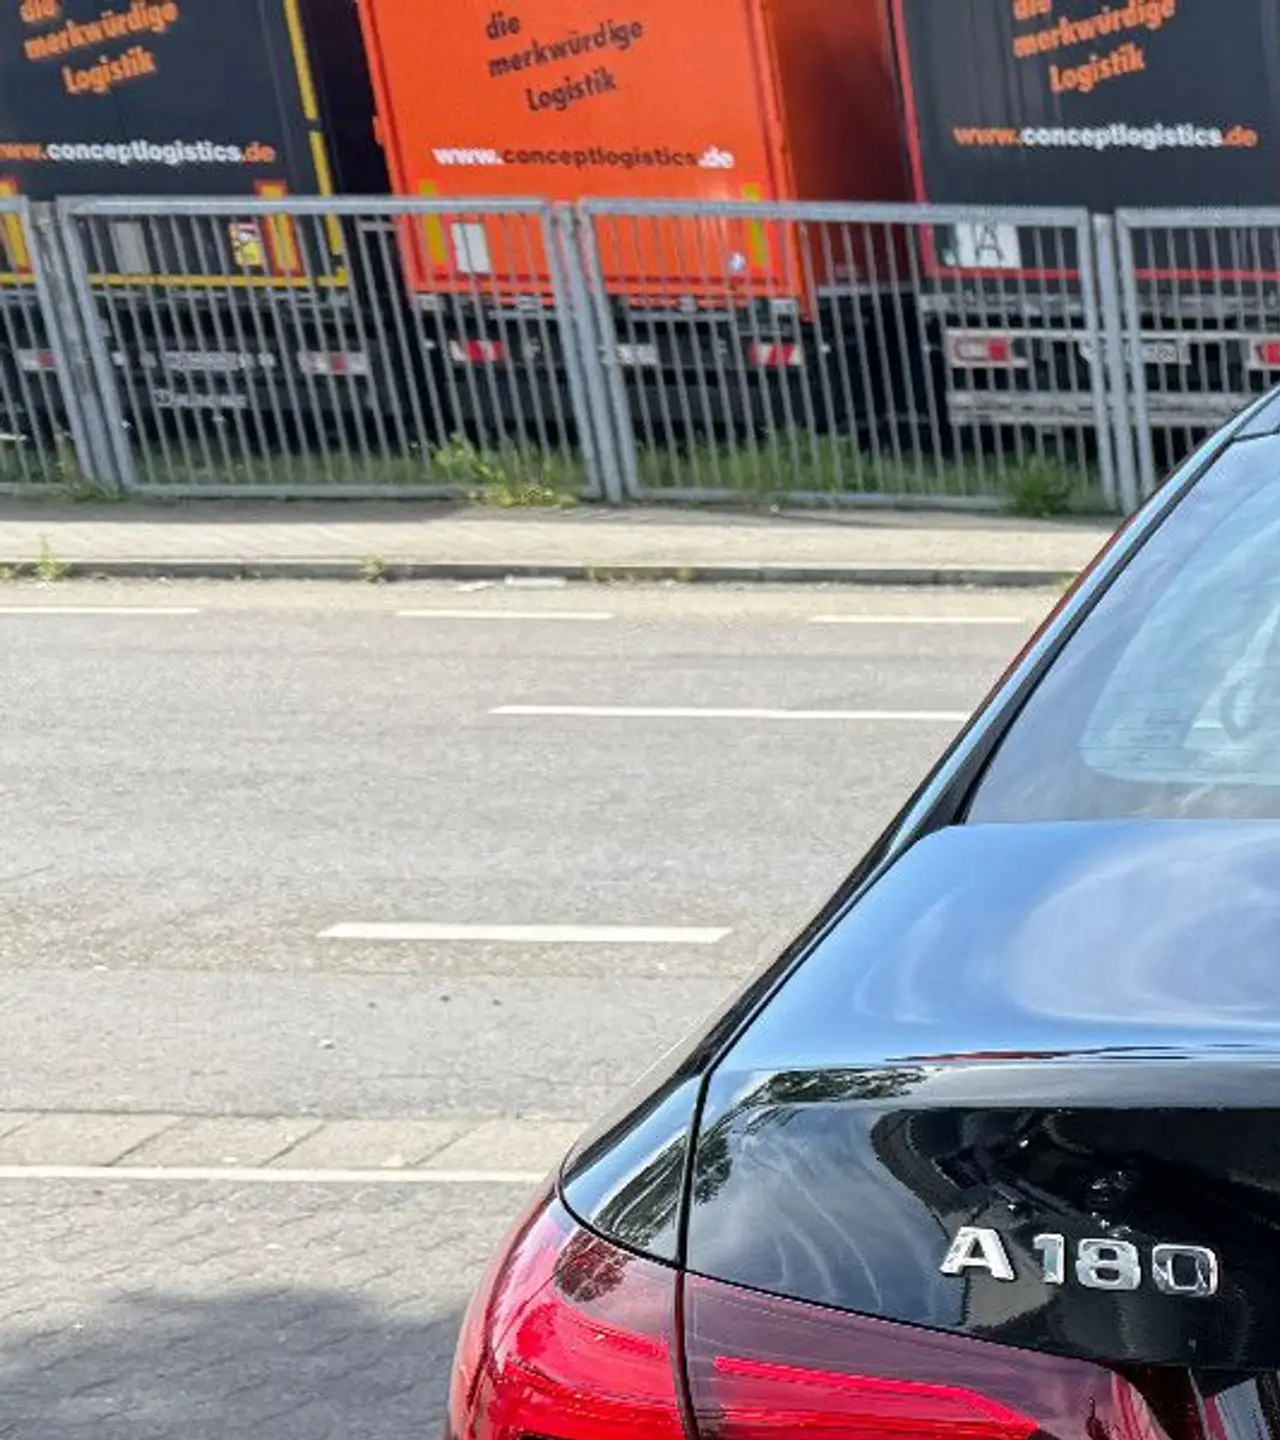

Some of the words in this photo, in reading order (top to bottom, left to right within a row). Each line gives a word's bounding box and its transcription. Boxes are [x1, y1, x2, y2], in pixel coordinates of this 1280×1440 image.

[24, 0, 178, 60] merkwürdige
[486, 11, 521, 40] die
[488, 19, 643, 77] merkwürdige
[1013, 0, 1176, 58] merkwürdige
[62, 46, 156, 94] Logistik
[525, 66, 617, 111] Logistik
[1050, 42, 1146, 93] Logistik
[0, 140, 276, 166] ww.conceptlogistics.de
[432, 145, 735, 169] www.conceptlogistics.de
[953, 123, 1258, 150] www.conceptlogistics.de
[939, 1226, 1016, 1281] A
[1032, 1233, 1219, 1297] 180
